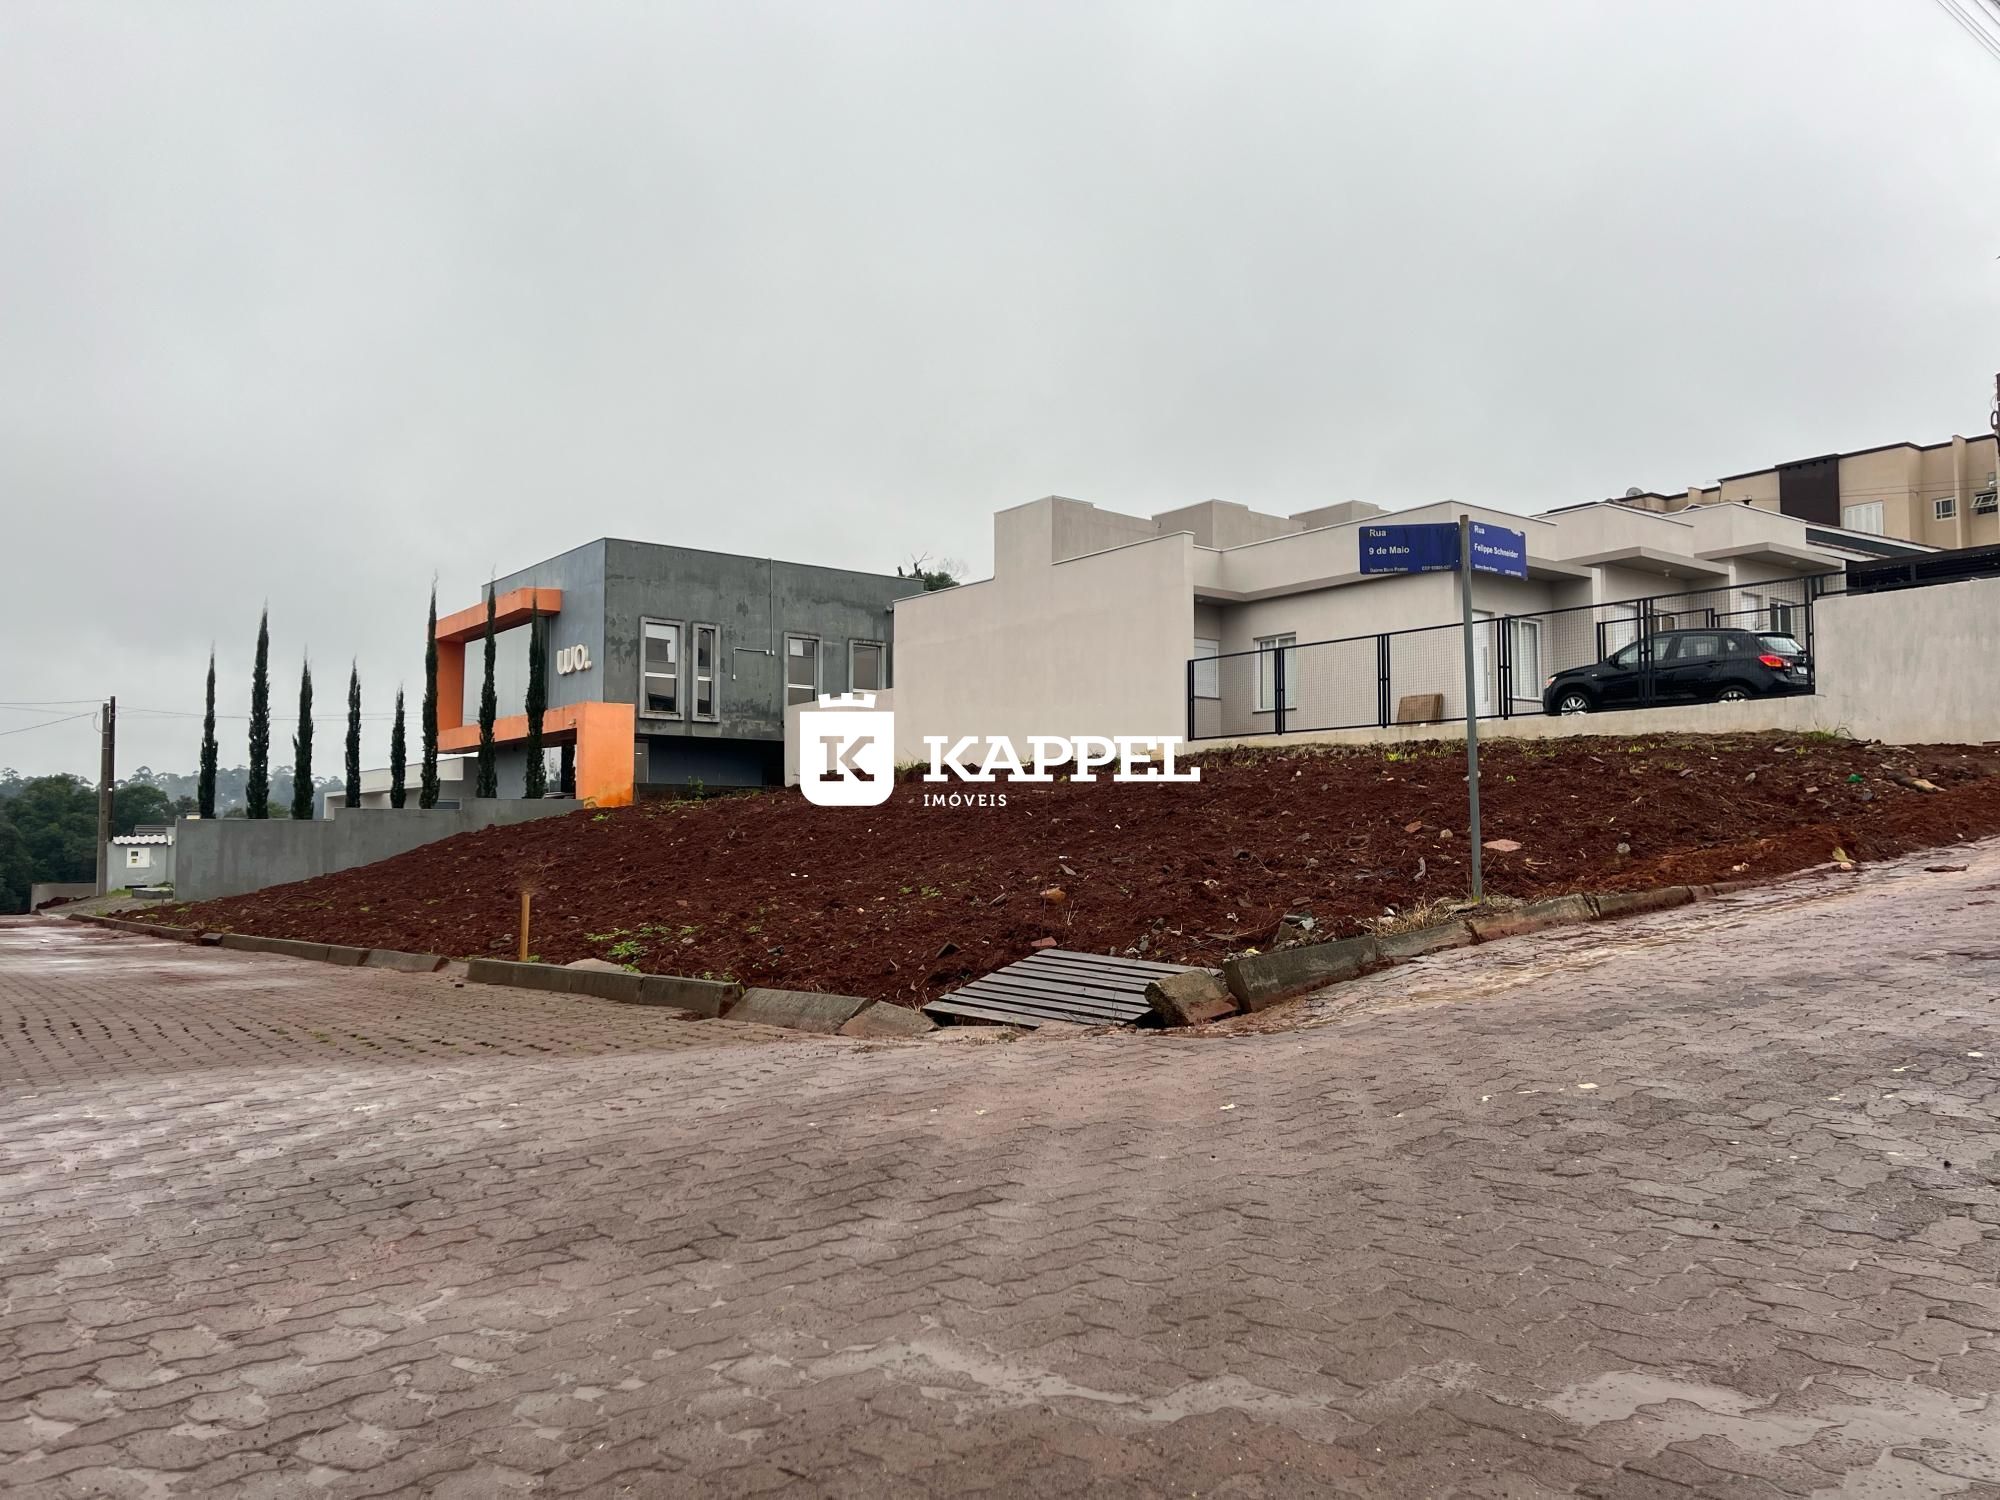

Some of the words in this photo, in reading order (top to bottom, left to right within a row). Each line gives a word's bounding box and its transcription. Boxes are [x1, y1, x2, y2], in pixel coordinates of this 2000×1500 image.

[1369, 528, 1387, 537] Rua
[1474, 525, 1485, 535] Rua
[1368, 547, 1375, 556] 9
[1376, 546, 1387, 555] de
[1389, 546, 1410, 554] Maio
[1474, 543, 1494, 555] Felippe
[1494, 546, 1519, 559] Schneider
